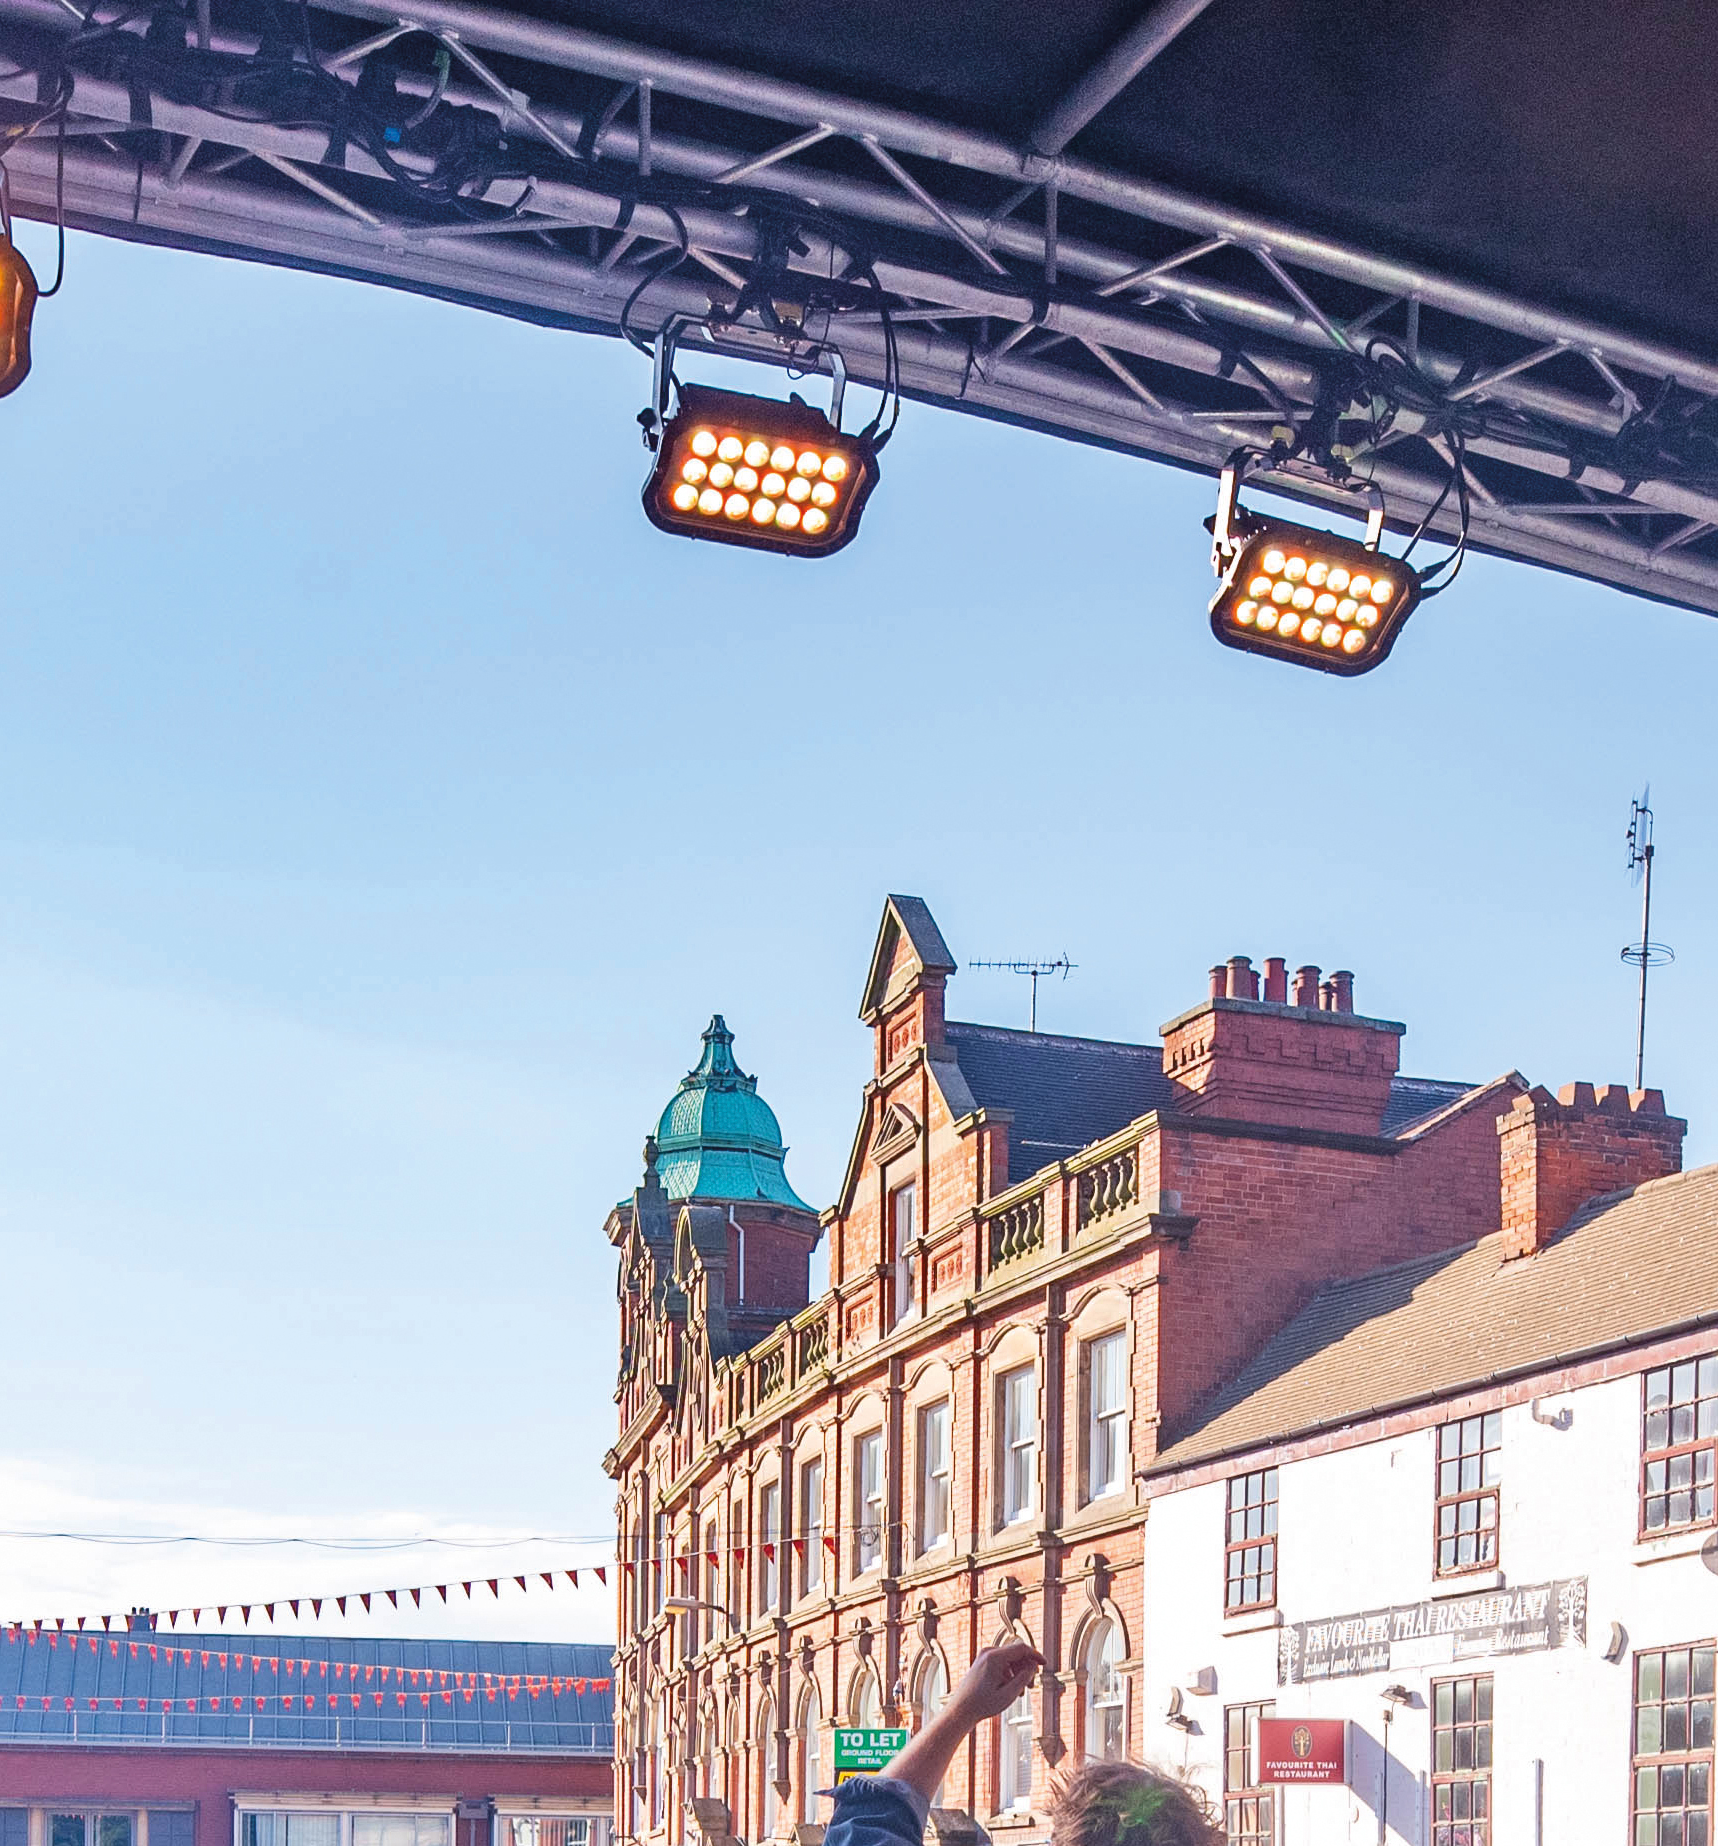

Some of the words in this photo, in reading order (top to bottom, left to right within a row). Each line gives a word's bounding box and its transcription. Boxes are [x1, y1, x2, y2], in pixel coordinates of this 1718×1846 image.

[1304, 1613, 1390, 1654] FAVOURITE
[1392, 1606, 1433, 1640] THAI
[1433, 1588, 1552, 1633] RESTAURANT
[840, 1732, 864, 1747] TO
[869, 1732, 901, 1747] LET
[1266, 1761, 1314, 1769] FAVOURITE
[1316, 1761, 1337, 1769] THAI
[1273, 1770, 1330, 1778] RESTAURANT
